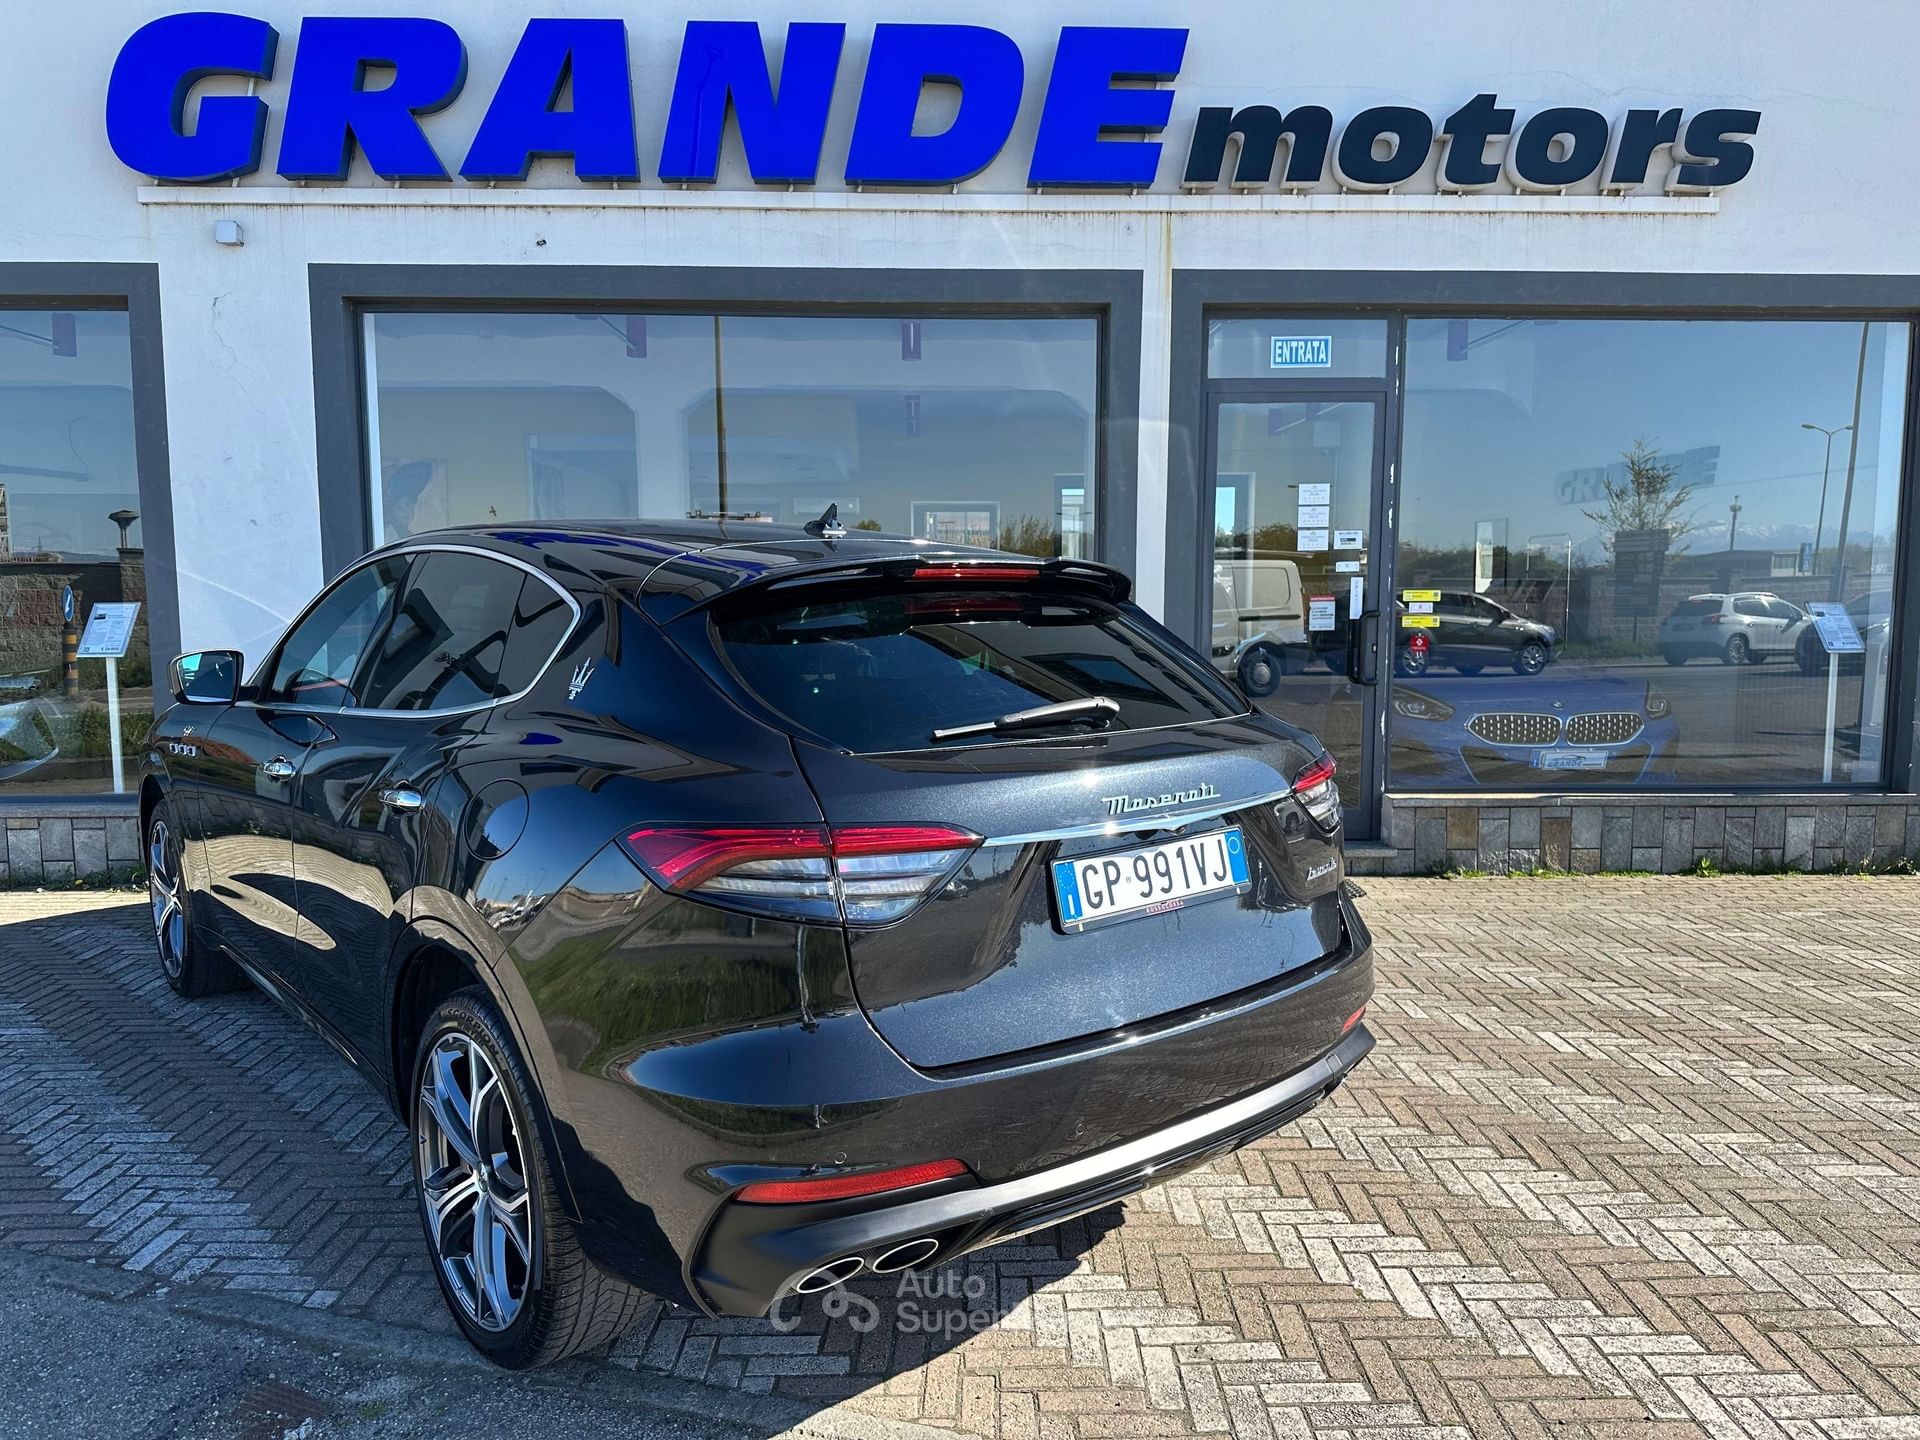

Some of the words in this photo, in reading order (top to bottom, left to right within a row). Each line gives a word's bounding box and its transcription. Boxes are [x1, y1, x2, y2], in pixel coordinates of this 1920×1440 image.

[106, 12, 1189, 188] GRANDE
[1182, 93, 1762, 190] motors
[1275, 340, 1327, 363] ENTRATA
[1101, 782, 1221, 815] Maserati
[1081, 860, 1121, 910] GP
[1132, 838, 1228, 898] 991VJ
[446, 1007, 500, 1057] SCORPION
